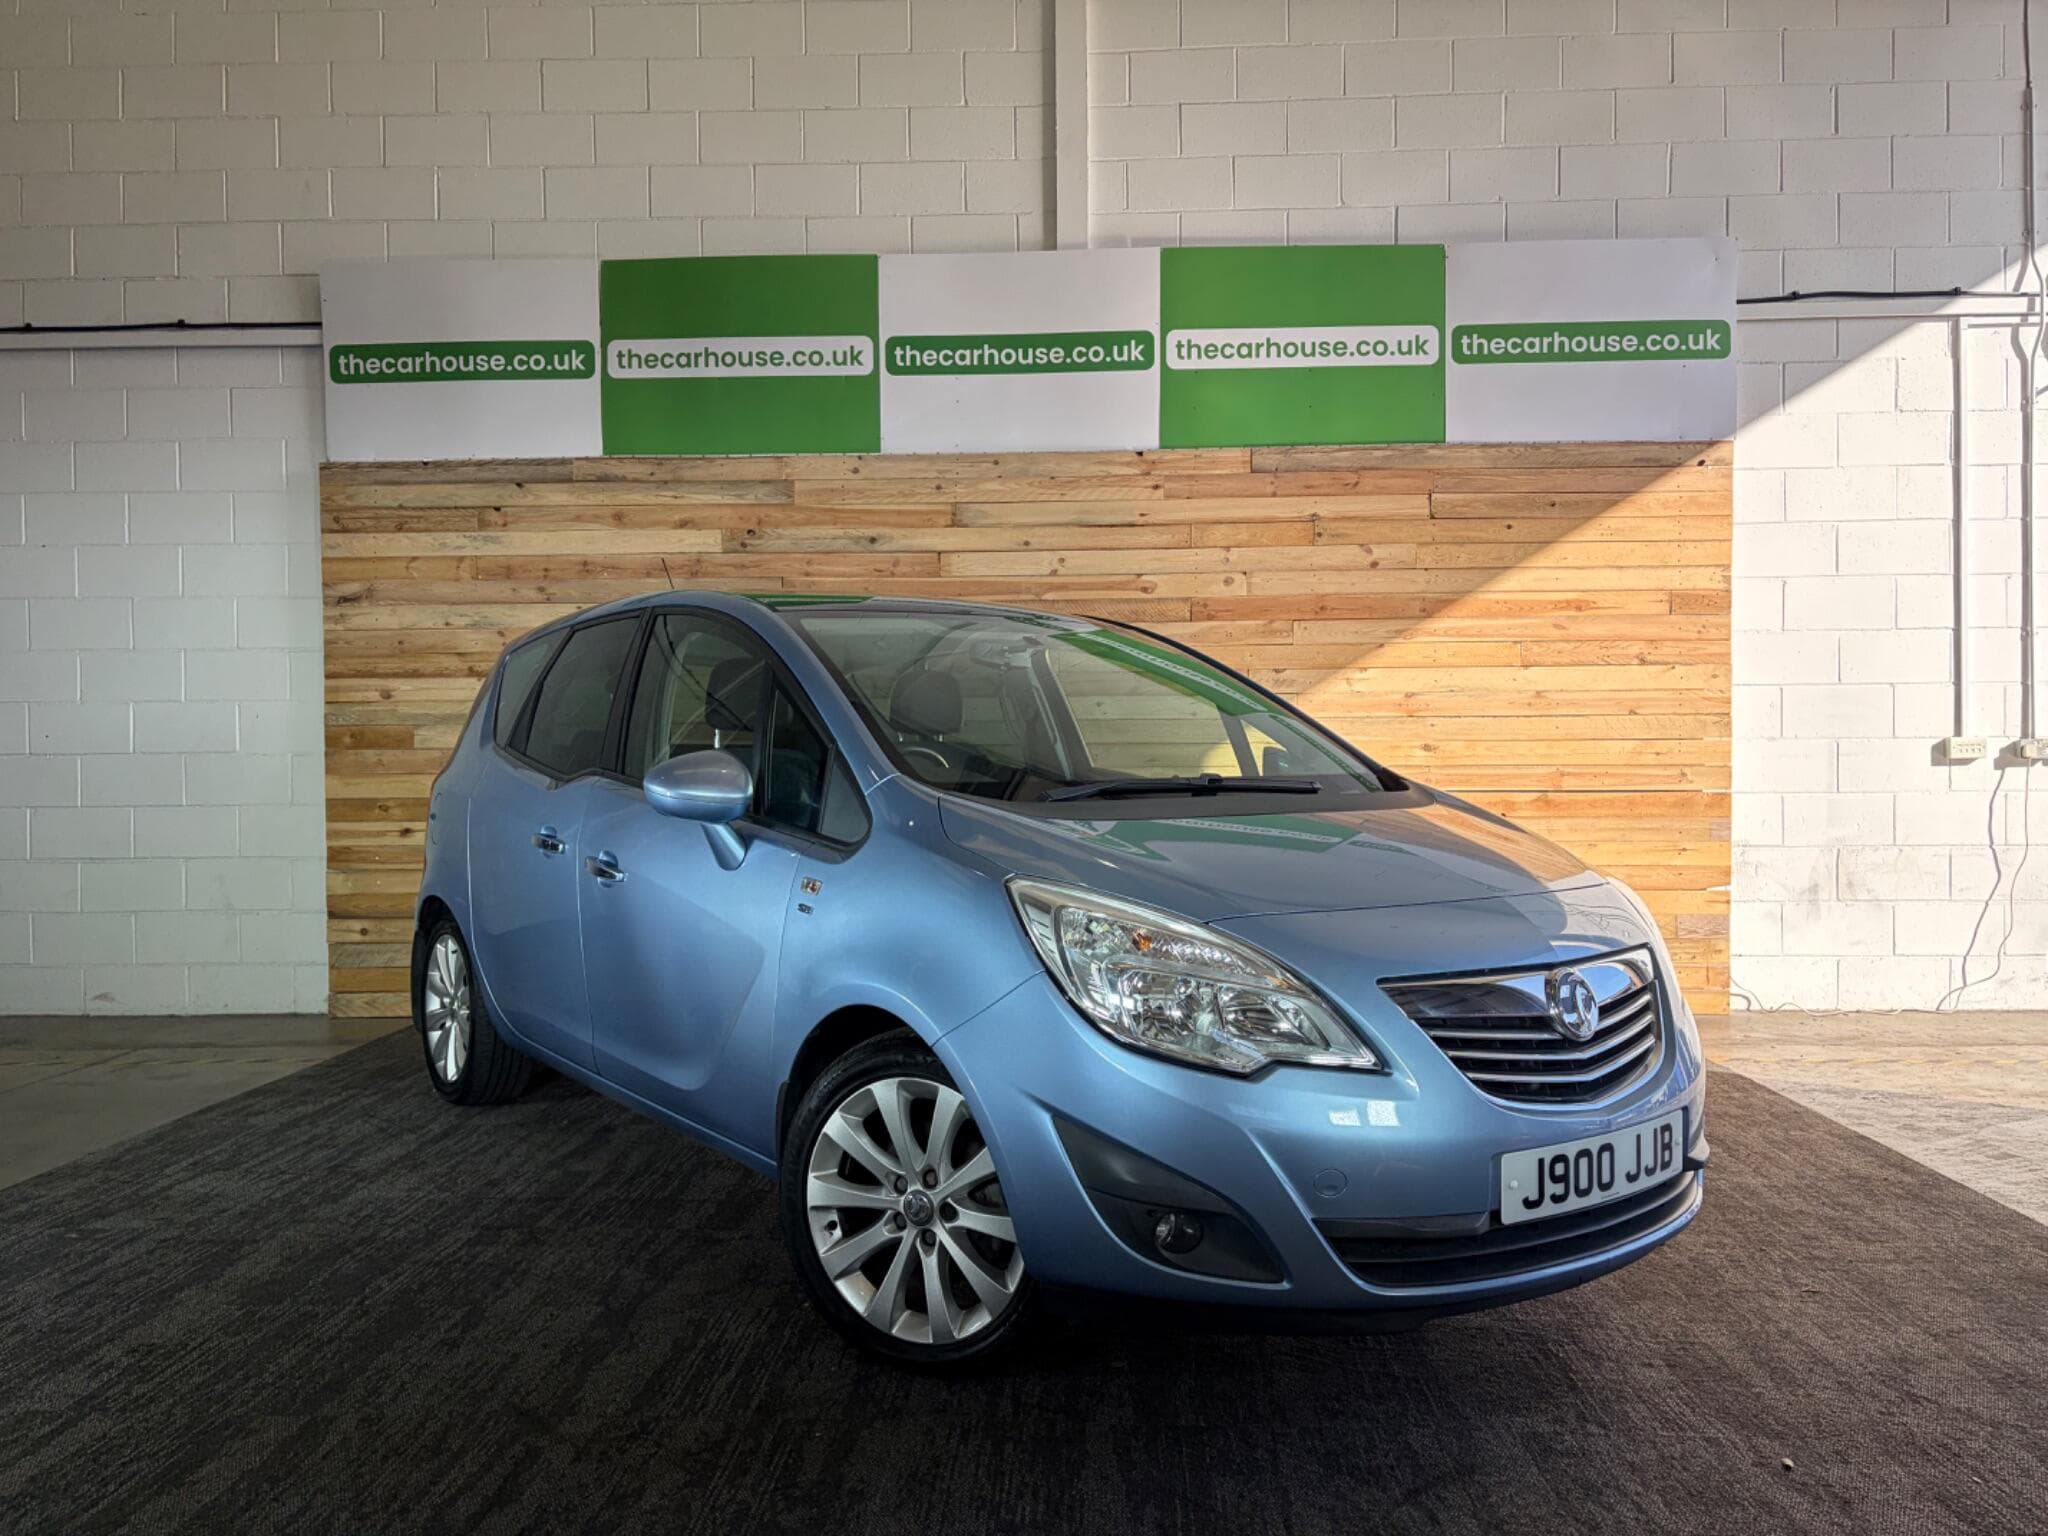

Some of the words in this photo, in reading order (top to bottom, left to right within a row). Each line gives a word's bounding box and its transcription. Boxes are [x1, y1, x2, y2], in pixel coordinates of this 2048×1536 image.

[894, 341, 1145, 368] thecarhouse.co.uk
[1175, 335, 1430, 361] thecarhouse.co.uk
[1461, 328, 1722, 356] thecarhouse.co.uk
[338, 350, 586, 375] thecarhouse.co.uk
[616, 346, 864, 370] thecarhouse.co.uk
[1522, 1142, 1615, 1210] J900
[1625, 1122, 1673, 1183] JJB
